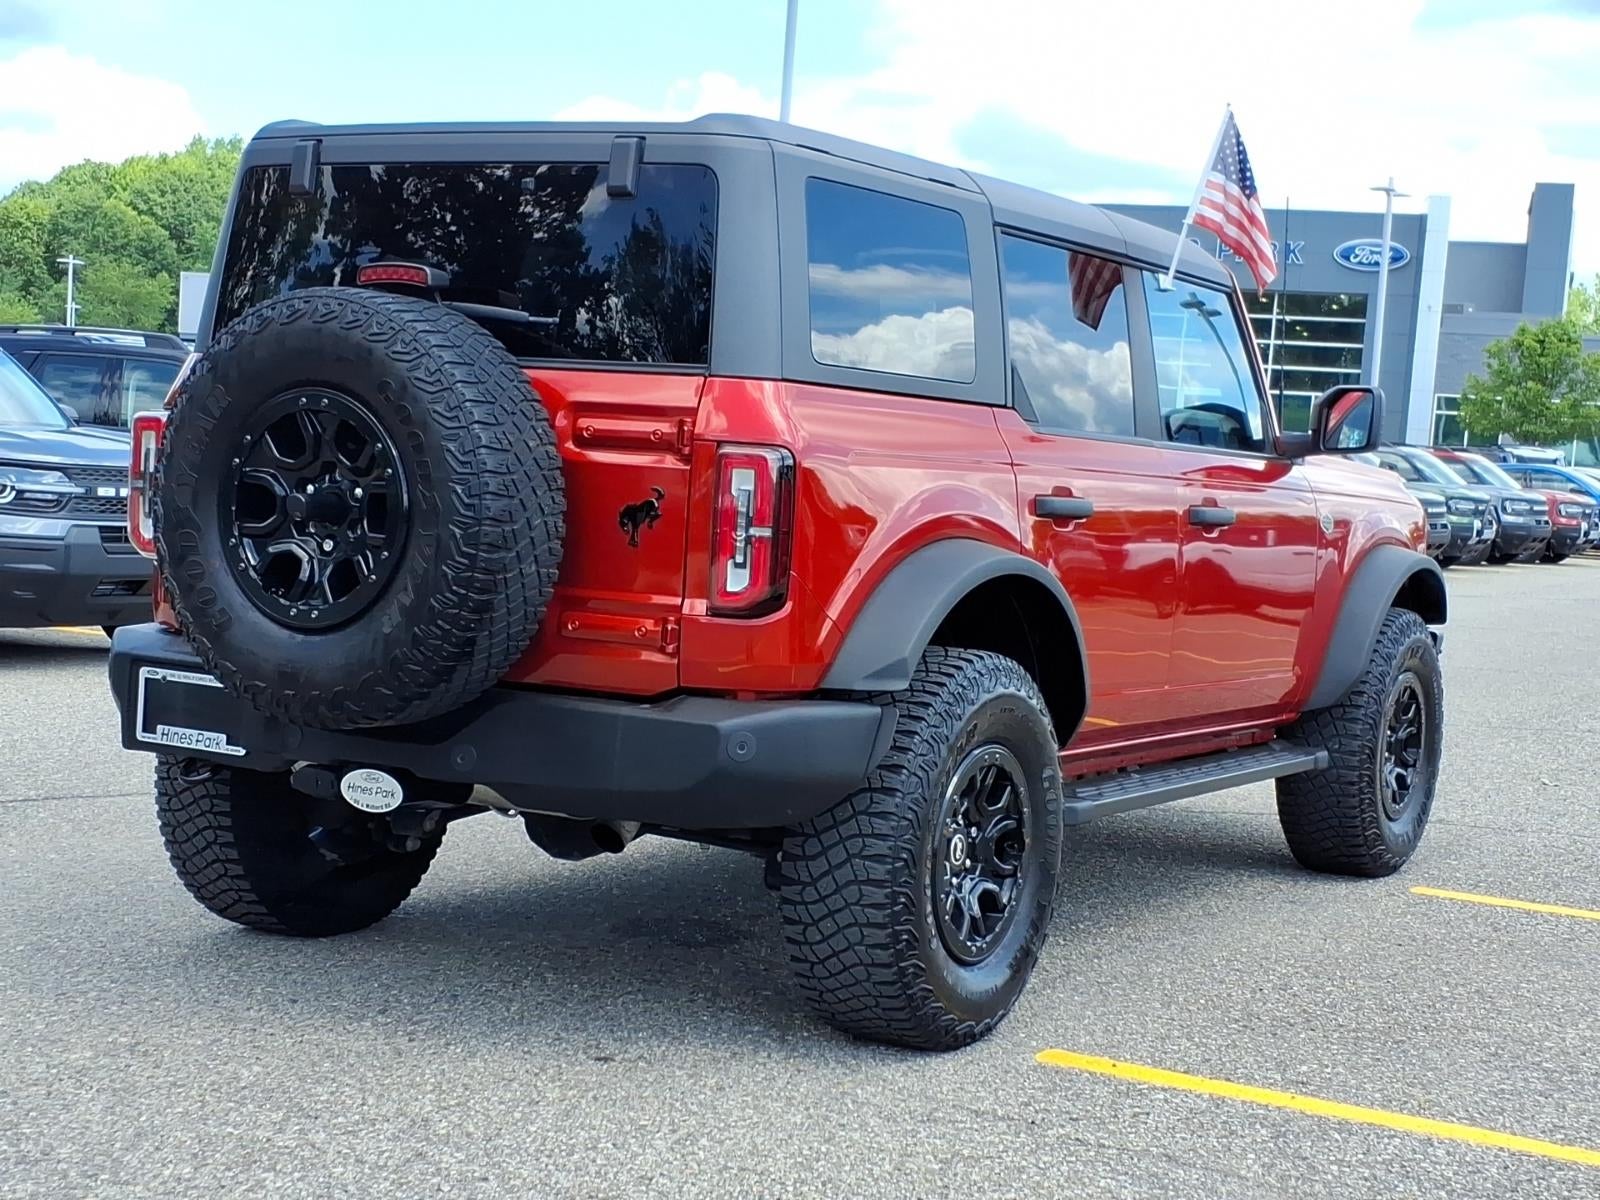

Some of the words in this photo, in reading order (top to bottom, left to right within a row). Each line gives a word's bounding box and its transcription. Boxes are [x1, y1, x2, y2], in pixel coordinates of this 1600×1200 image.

[1215, 237, 1304, 265] PK
[160, 728, 194, 746] Hines
[195, 733, 223, 750] Park
[348, 782, 373, 796] Hines
[376, 786, 397, 799] Park
